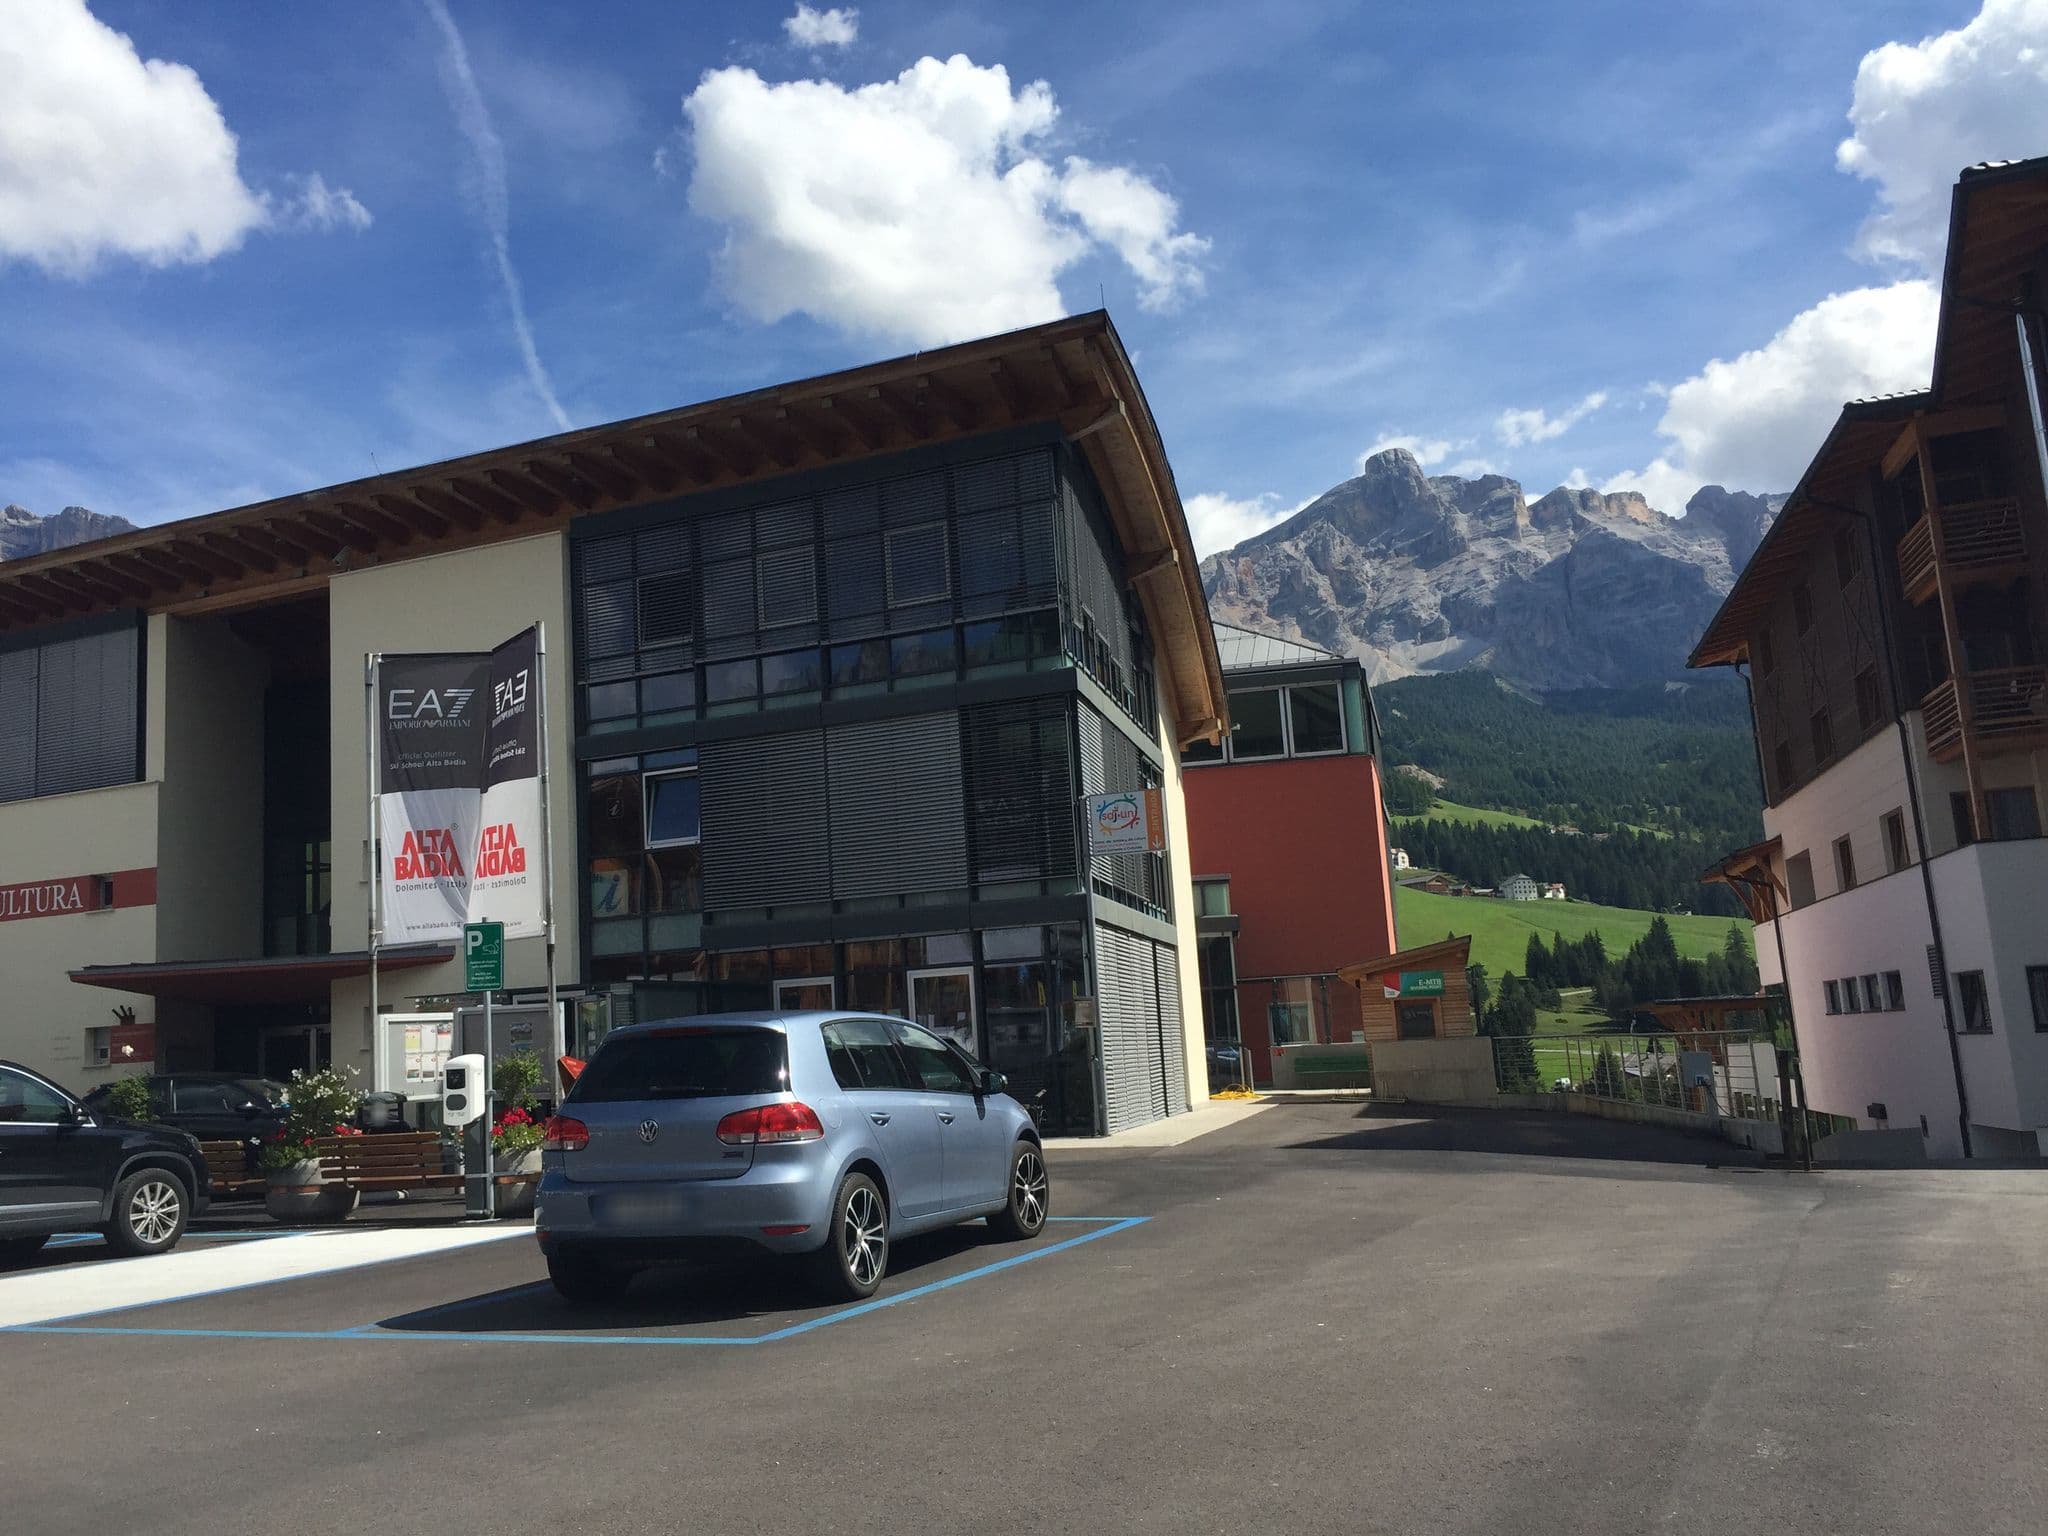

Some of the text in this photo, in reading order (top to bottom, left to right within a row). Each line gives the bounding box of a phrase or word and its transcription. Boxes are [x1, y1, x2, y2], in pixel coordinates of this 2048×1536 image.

[388, 688, 475, 719] EA7
[437, 719, 471, 728] ARMANI
[401, 761, 424, 769] School
[402, 829, 457, 854] ALTA
[394, 853, 465, 880] BADIA
[395, 883, 437, 892] Dolomites
[467, 931, 483, 955] P
